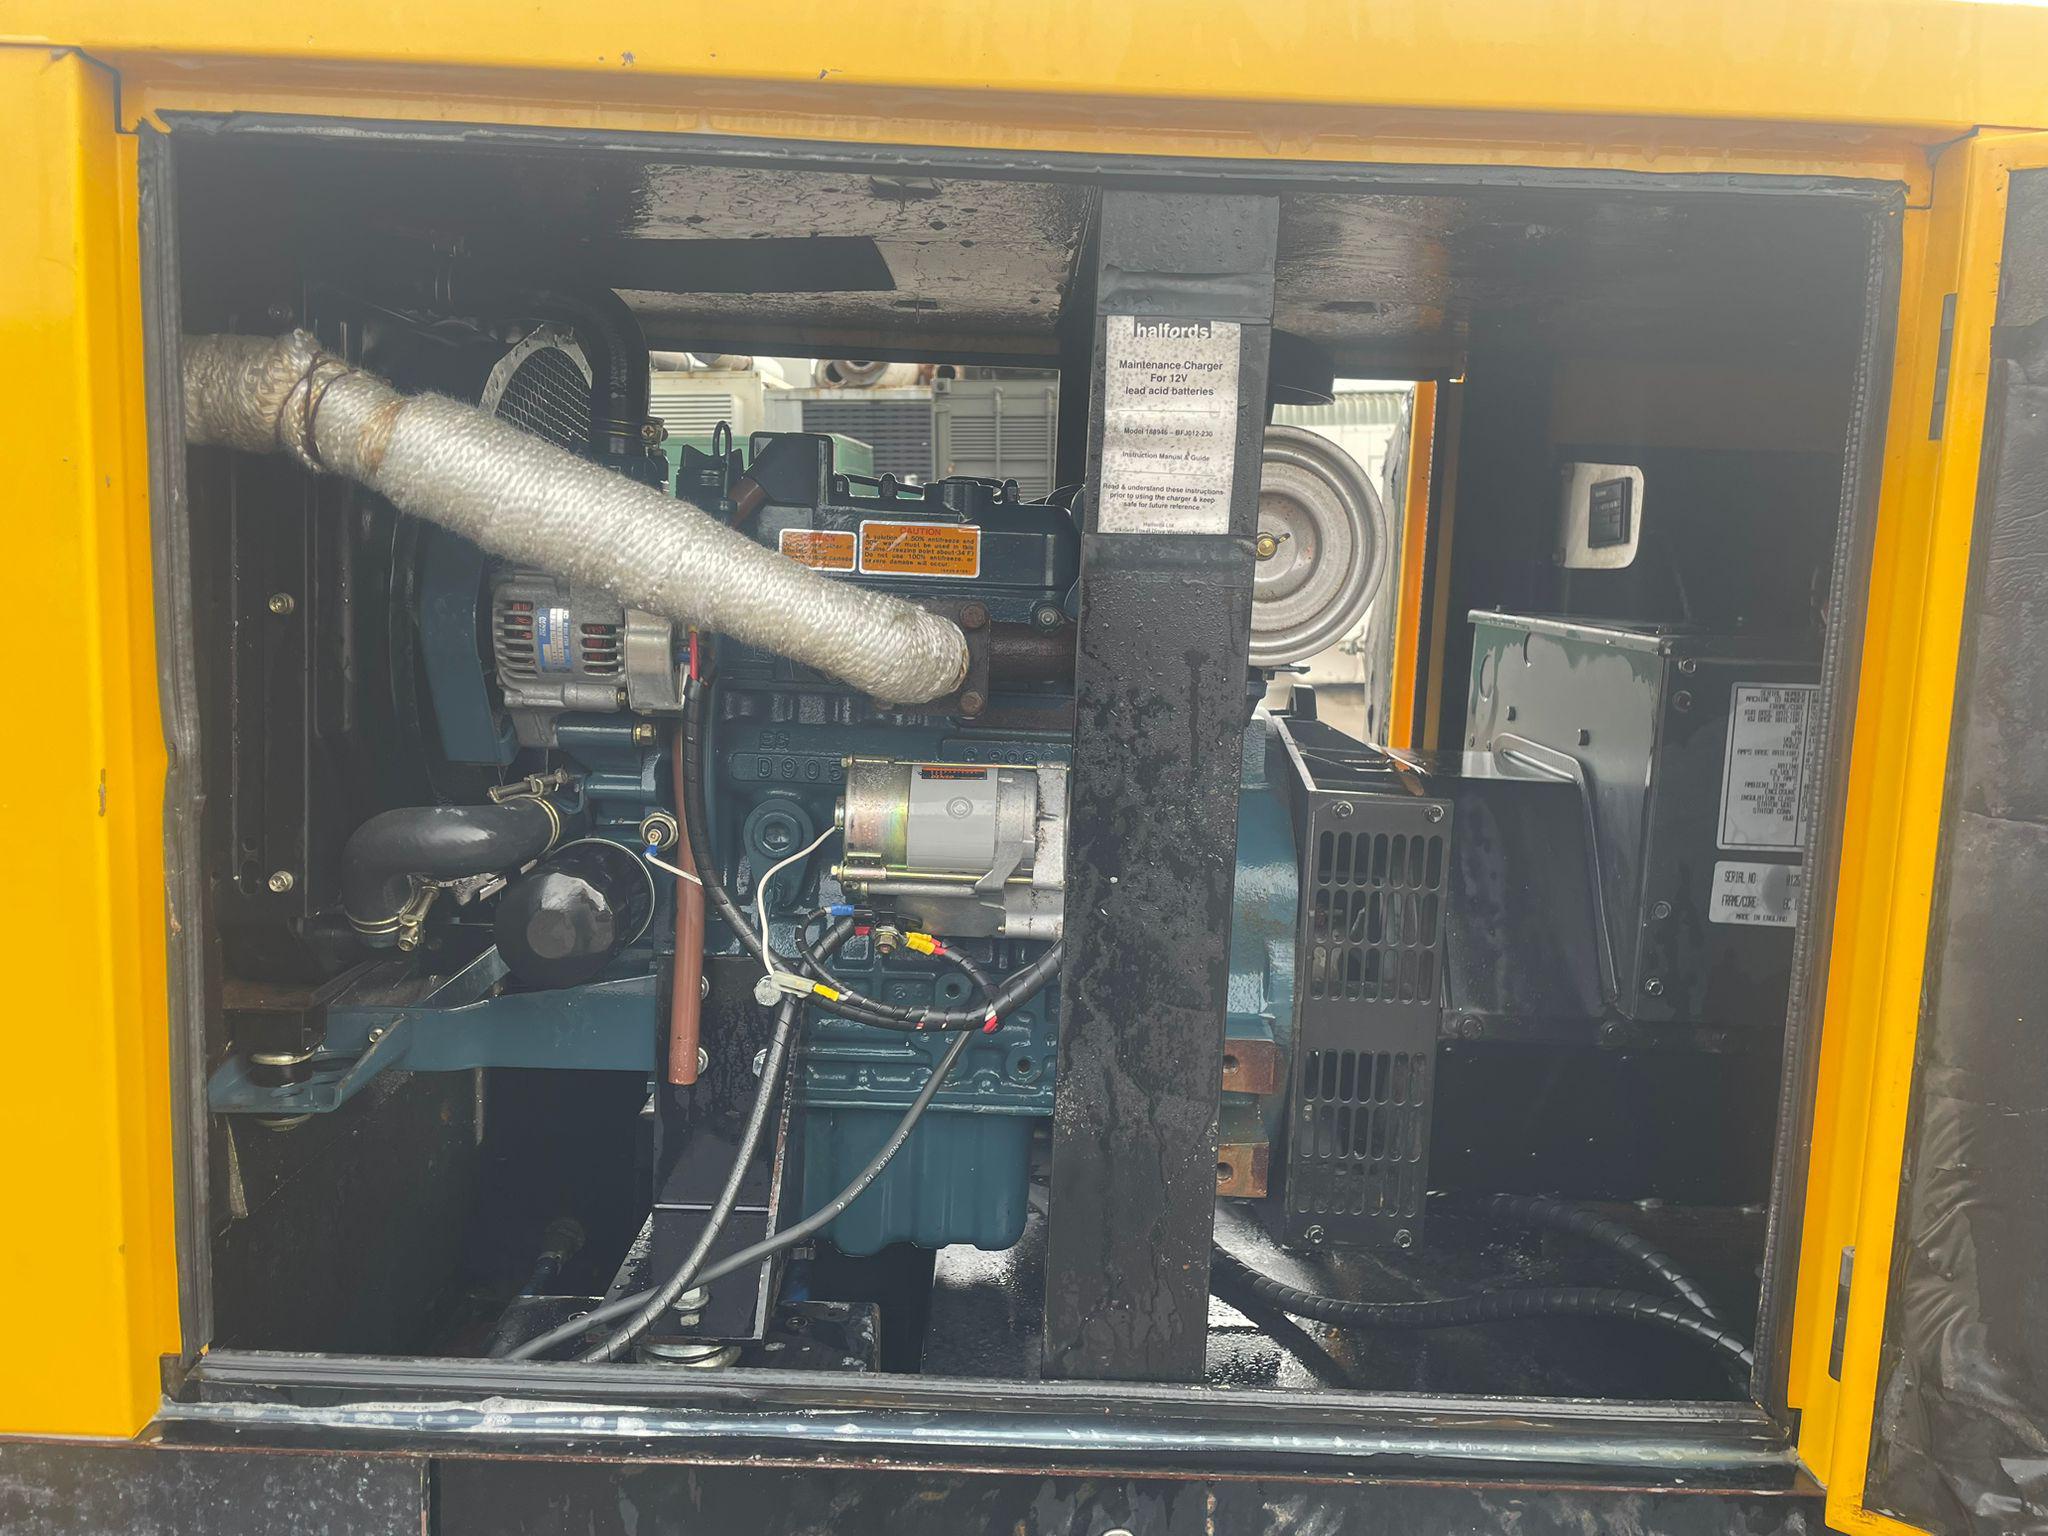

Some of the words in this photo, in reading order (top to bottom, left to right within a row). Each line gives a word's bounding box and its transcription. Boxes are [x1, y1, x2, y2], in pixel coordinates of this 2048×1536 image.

[1136, 323, 1210, 338] halfords
[1119, 360, 1182, 370] Maintenance
[1183, 361, 1224, 372] Charger
[1150, 374, 1167, 382] For
[1170, 374, 1188, 382] 12V
[1125, 387, 1146, 396] lead
[1149, 387, 1170, 396] acid
[1172, 387, 1214, 396] batteries
[1124, 428, 1144, 436] Model
[1122, 452, 1158, 460] Instruction
[1190, 454, 1210, 462] Guide
[1127, 484, 1164, 492] understand
[1110, 492, 1126, 501] prior
[1135, 494, 1154, 502] using
[900, 526, 942, 536] CAUTION
[757, 757, 842, 782] D905
[1724, 870, 1746, 884] SERIAL
[876, 1130, 909, 1172] ELANDFLEX
